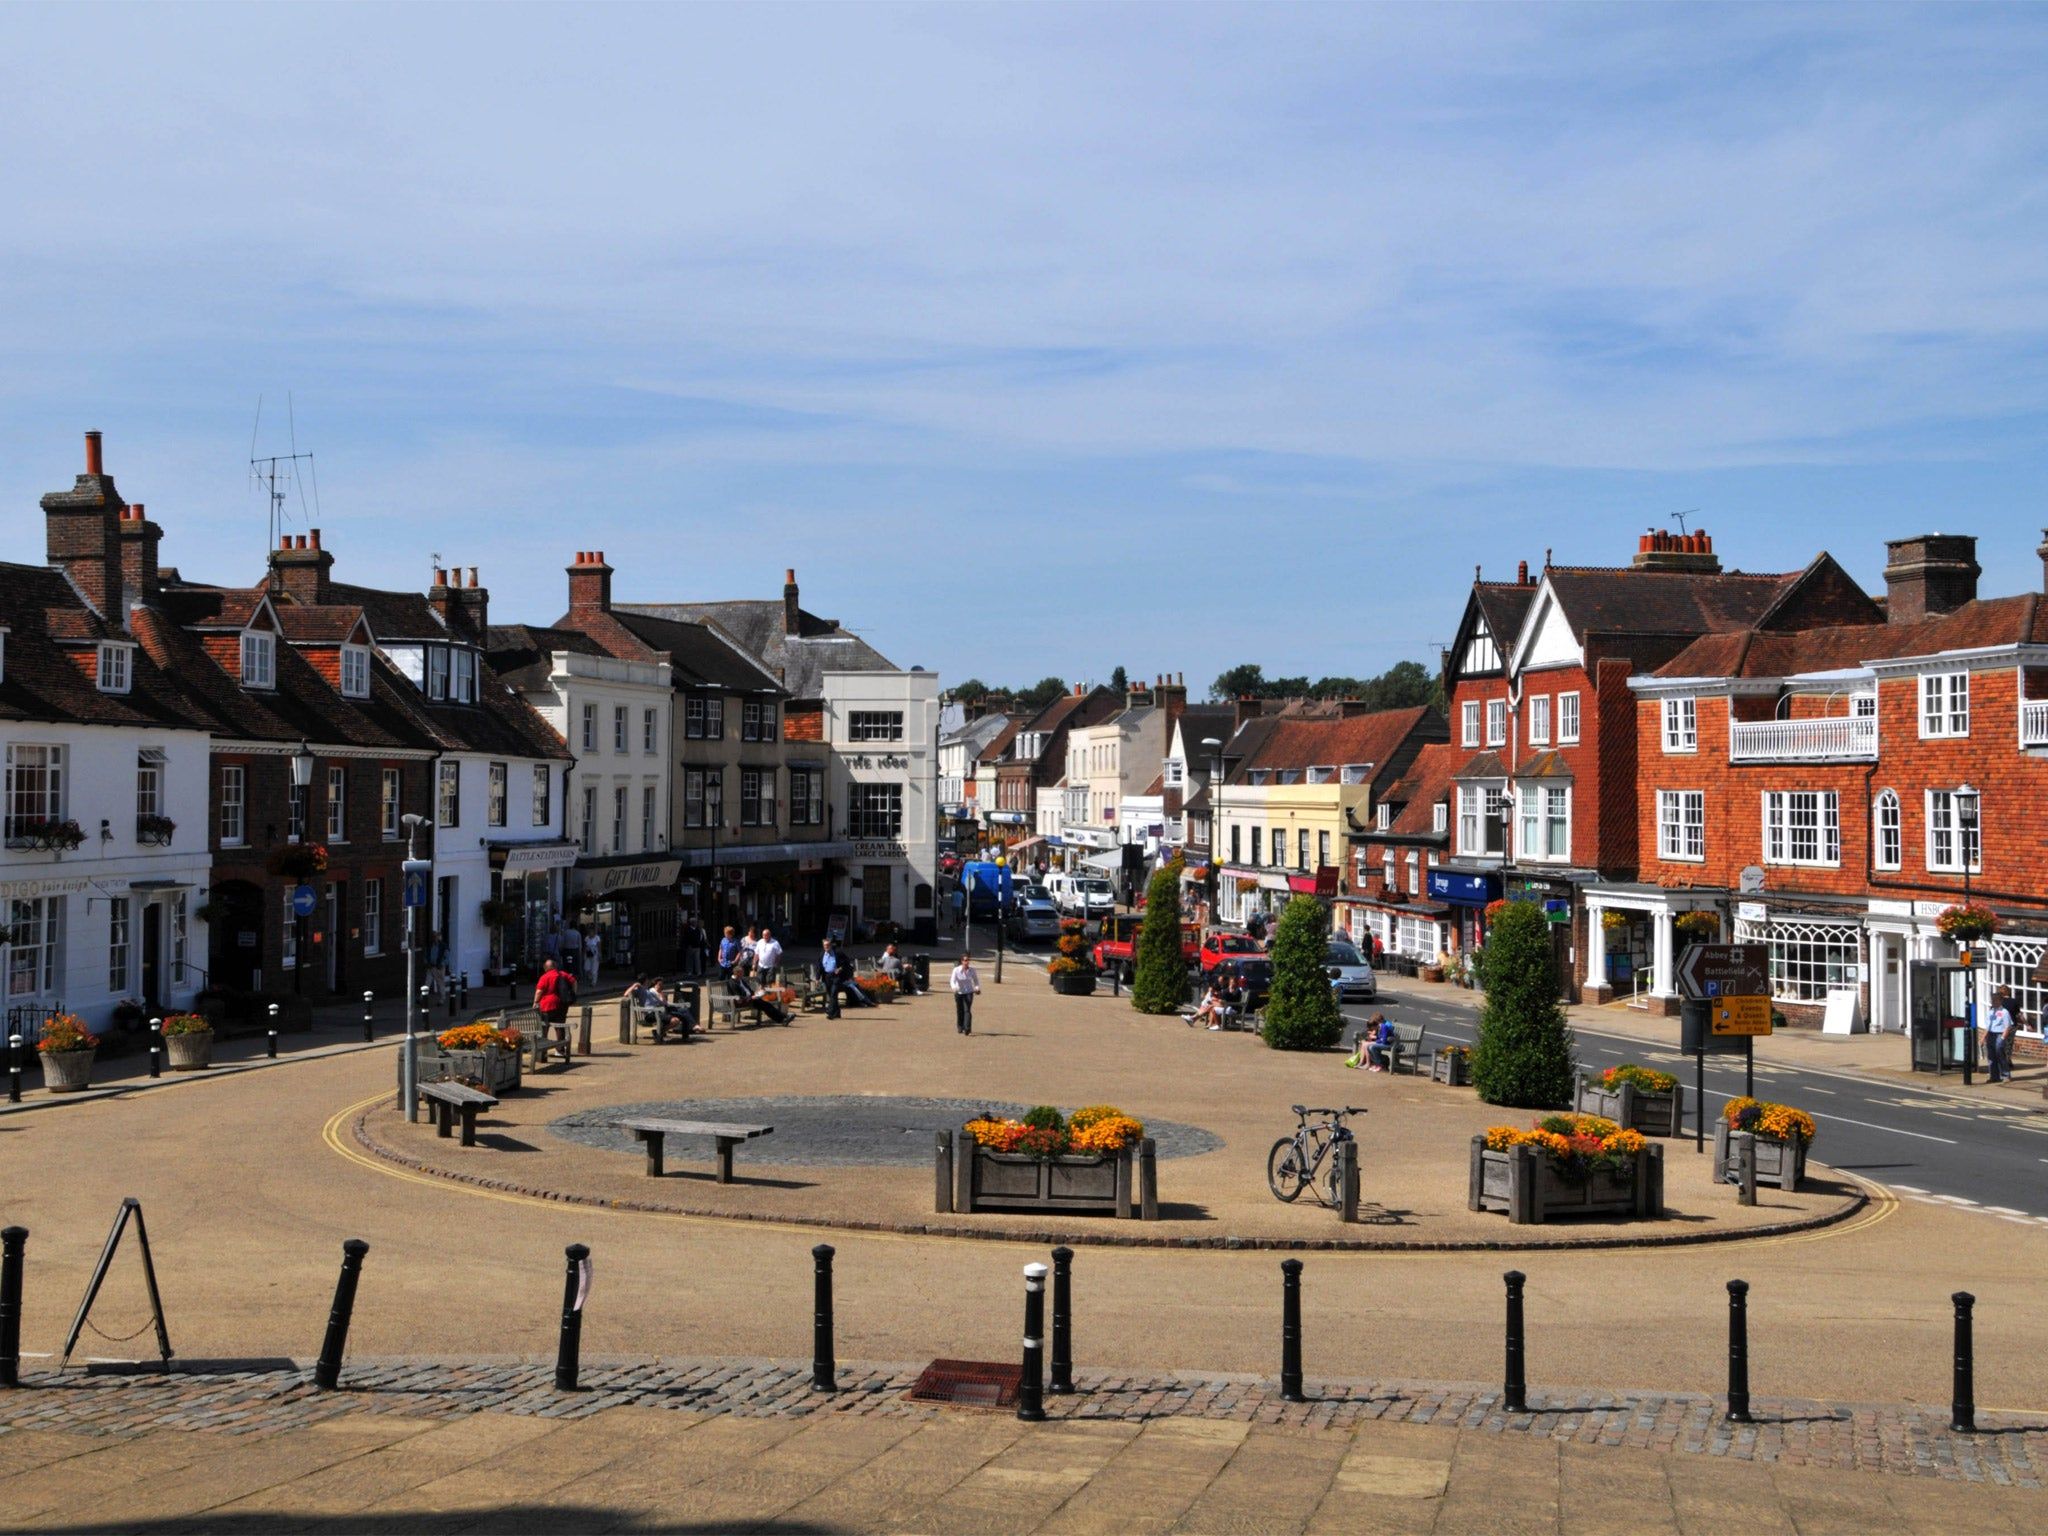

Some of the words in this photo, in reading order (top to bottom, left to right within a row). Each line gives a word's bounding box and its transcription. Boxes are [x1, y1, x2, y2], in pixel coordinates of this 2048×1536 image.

[845, 758, 871, 769] THE
[510, 851, 536, 862] BATTLE
[604, 868, 630, 888] GIFT
[630, 866, 661, 883] WORLD
[1921, 903, 1943, 914] HSBC
[1705, 951, 1728, 959] Abbey
[1705, 967, 1745, 975] Battlefield
